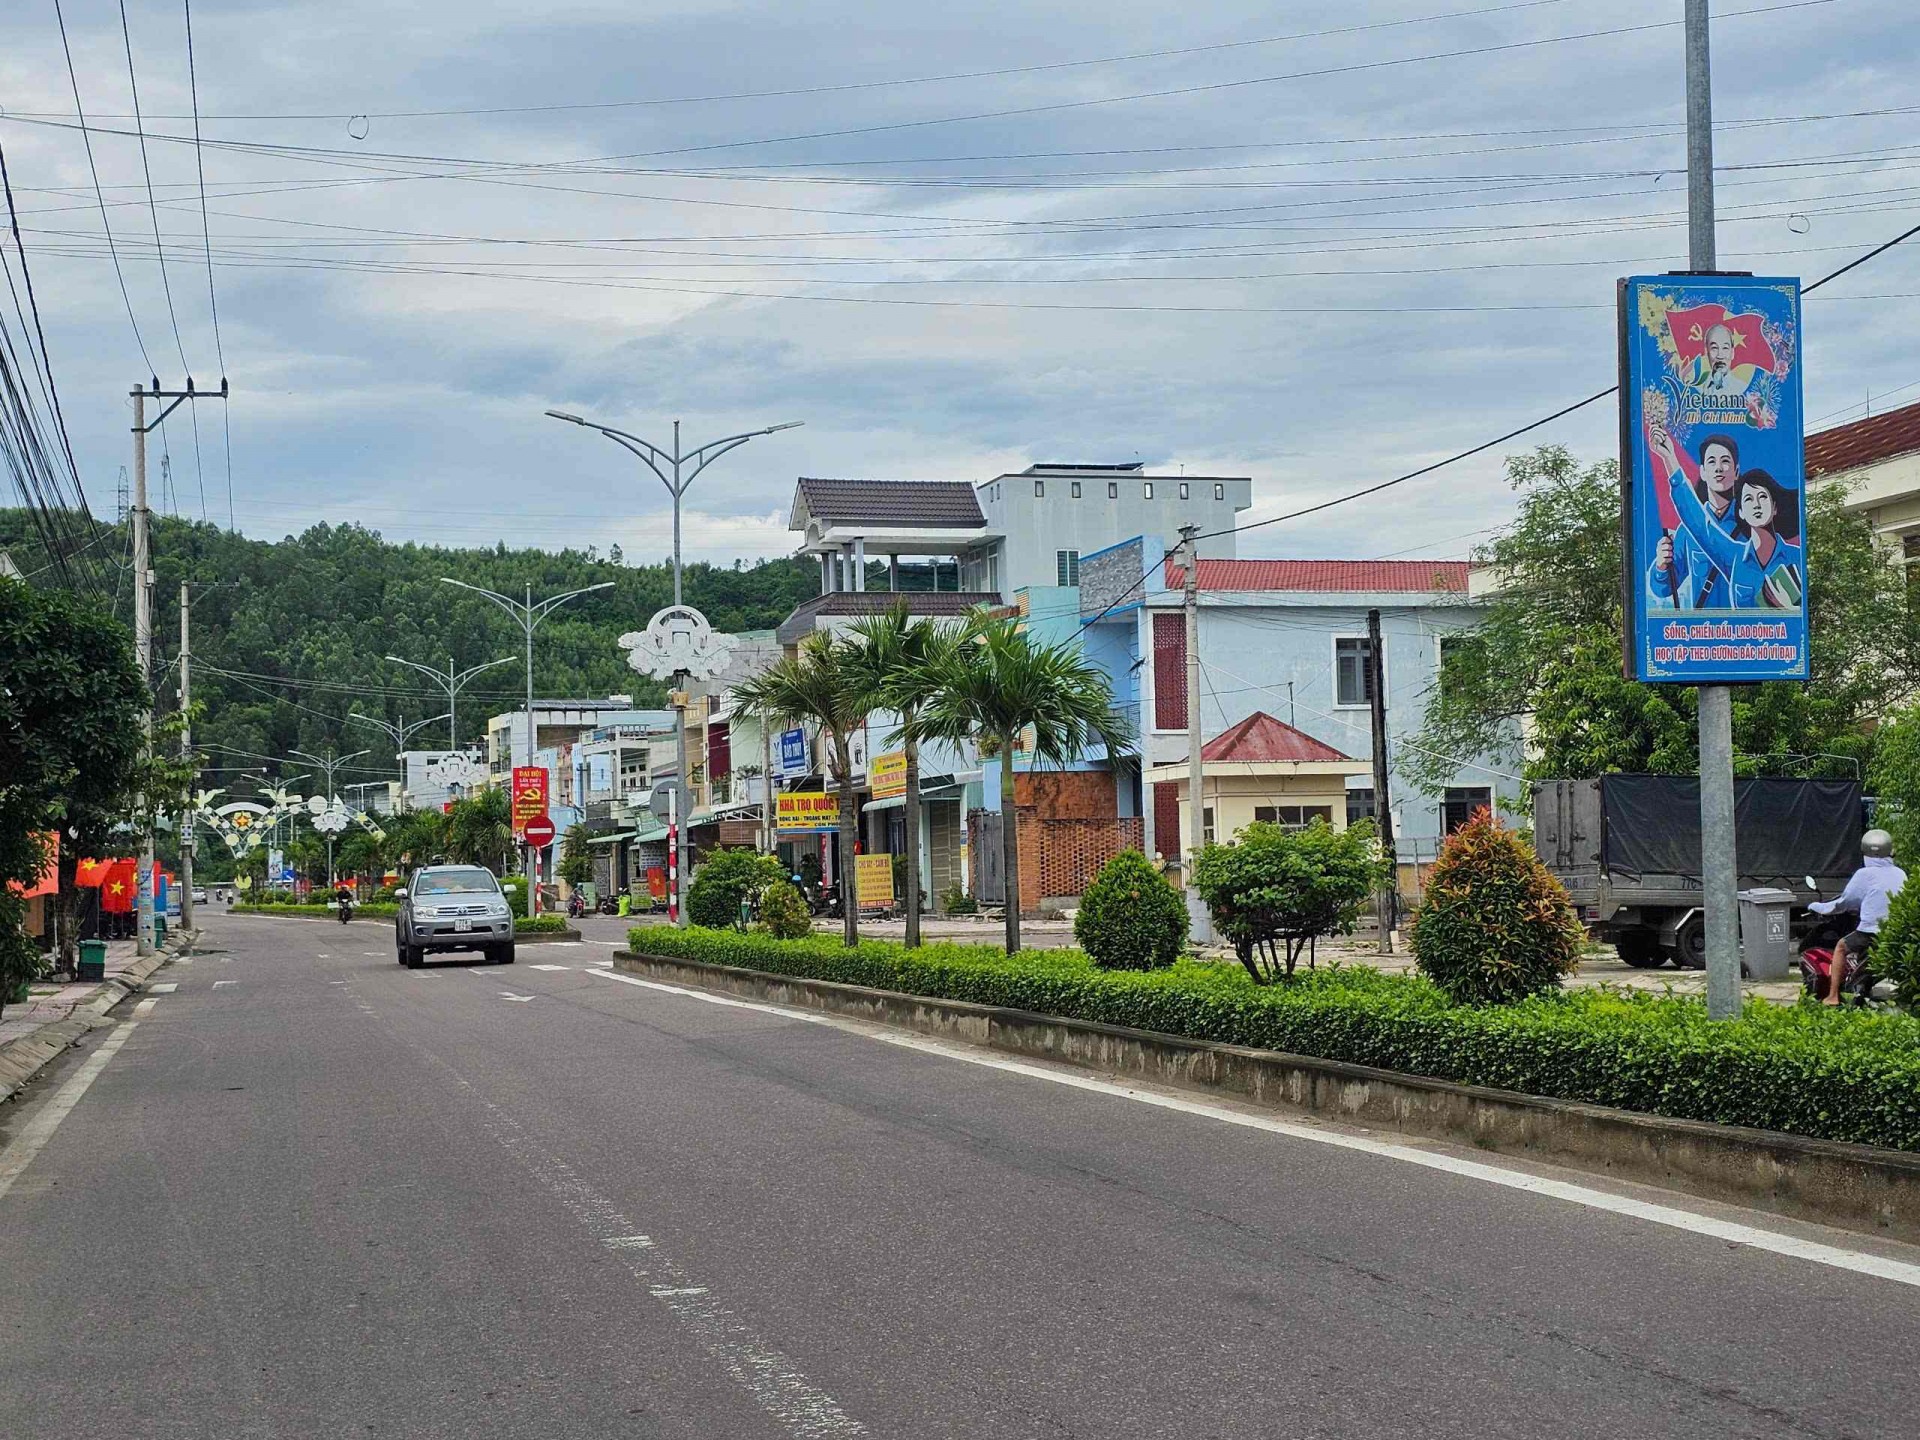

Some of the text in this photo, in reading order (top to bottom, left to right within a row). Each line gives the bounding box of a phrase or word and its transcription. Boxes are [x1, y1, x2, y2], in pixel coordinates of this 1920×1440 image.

[1720, 411, 1745, 424] Minh
[1664, 620, 1787, 642] SỐNG, CHIẾN ĐẤU, LAO ĐỘNG VÀ
[1655, 647, 1671, 664] HỌC
[1673, 644, 1689, 664] TẬP
[1690, 646, 1710, 661] THEO
[1711, 645, 1738, 661] GƯƠNG
[1740, 643, 1756, 661] BÁC
[1757, 642, 1769, 661] HỒ
[1769, 643, 1779, 660] VĨ
[780, 797, 794, 811] NHÀ
[796, 799, 811, 813] TRỌ
[813, 795, 834, 812] QUỐC
